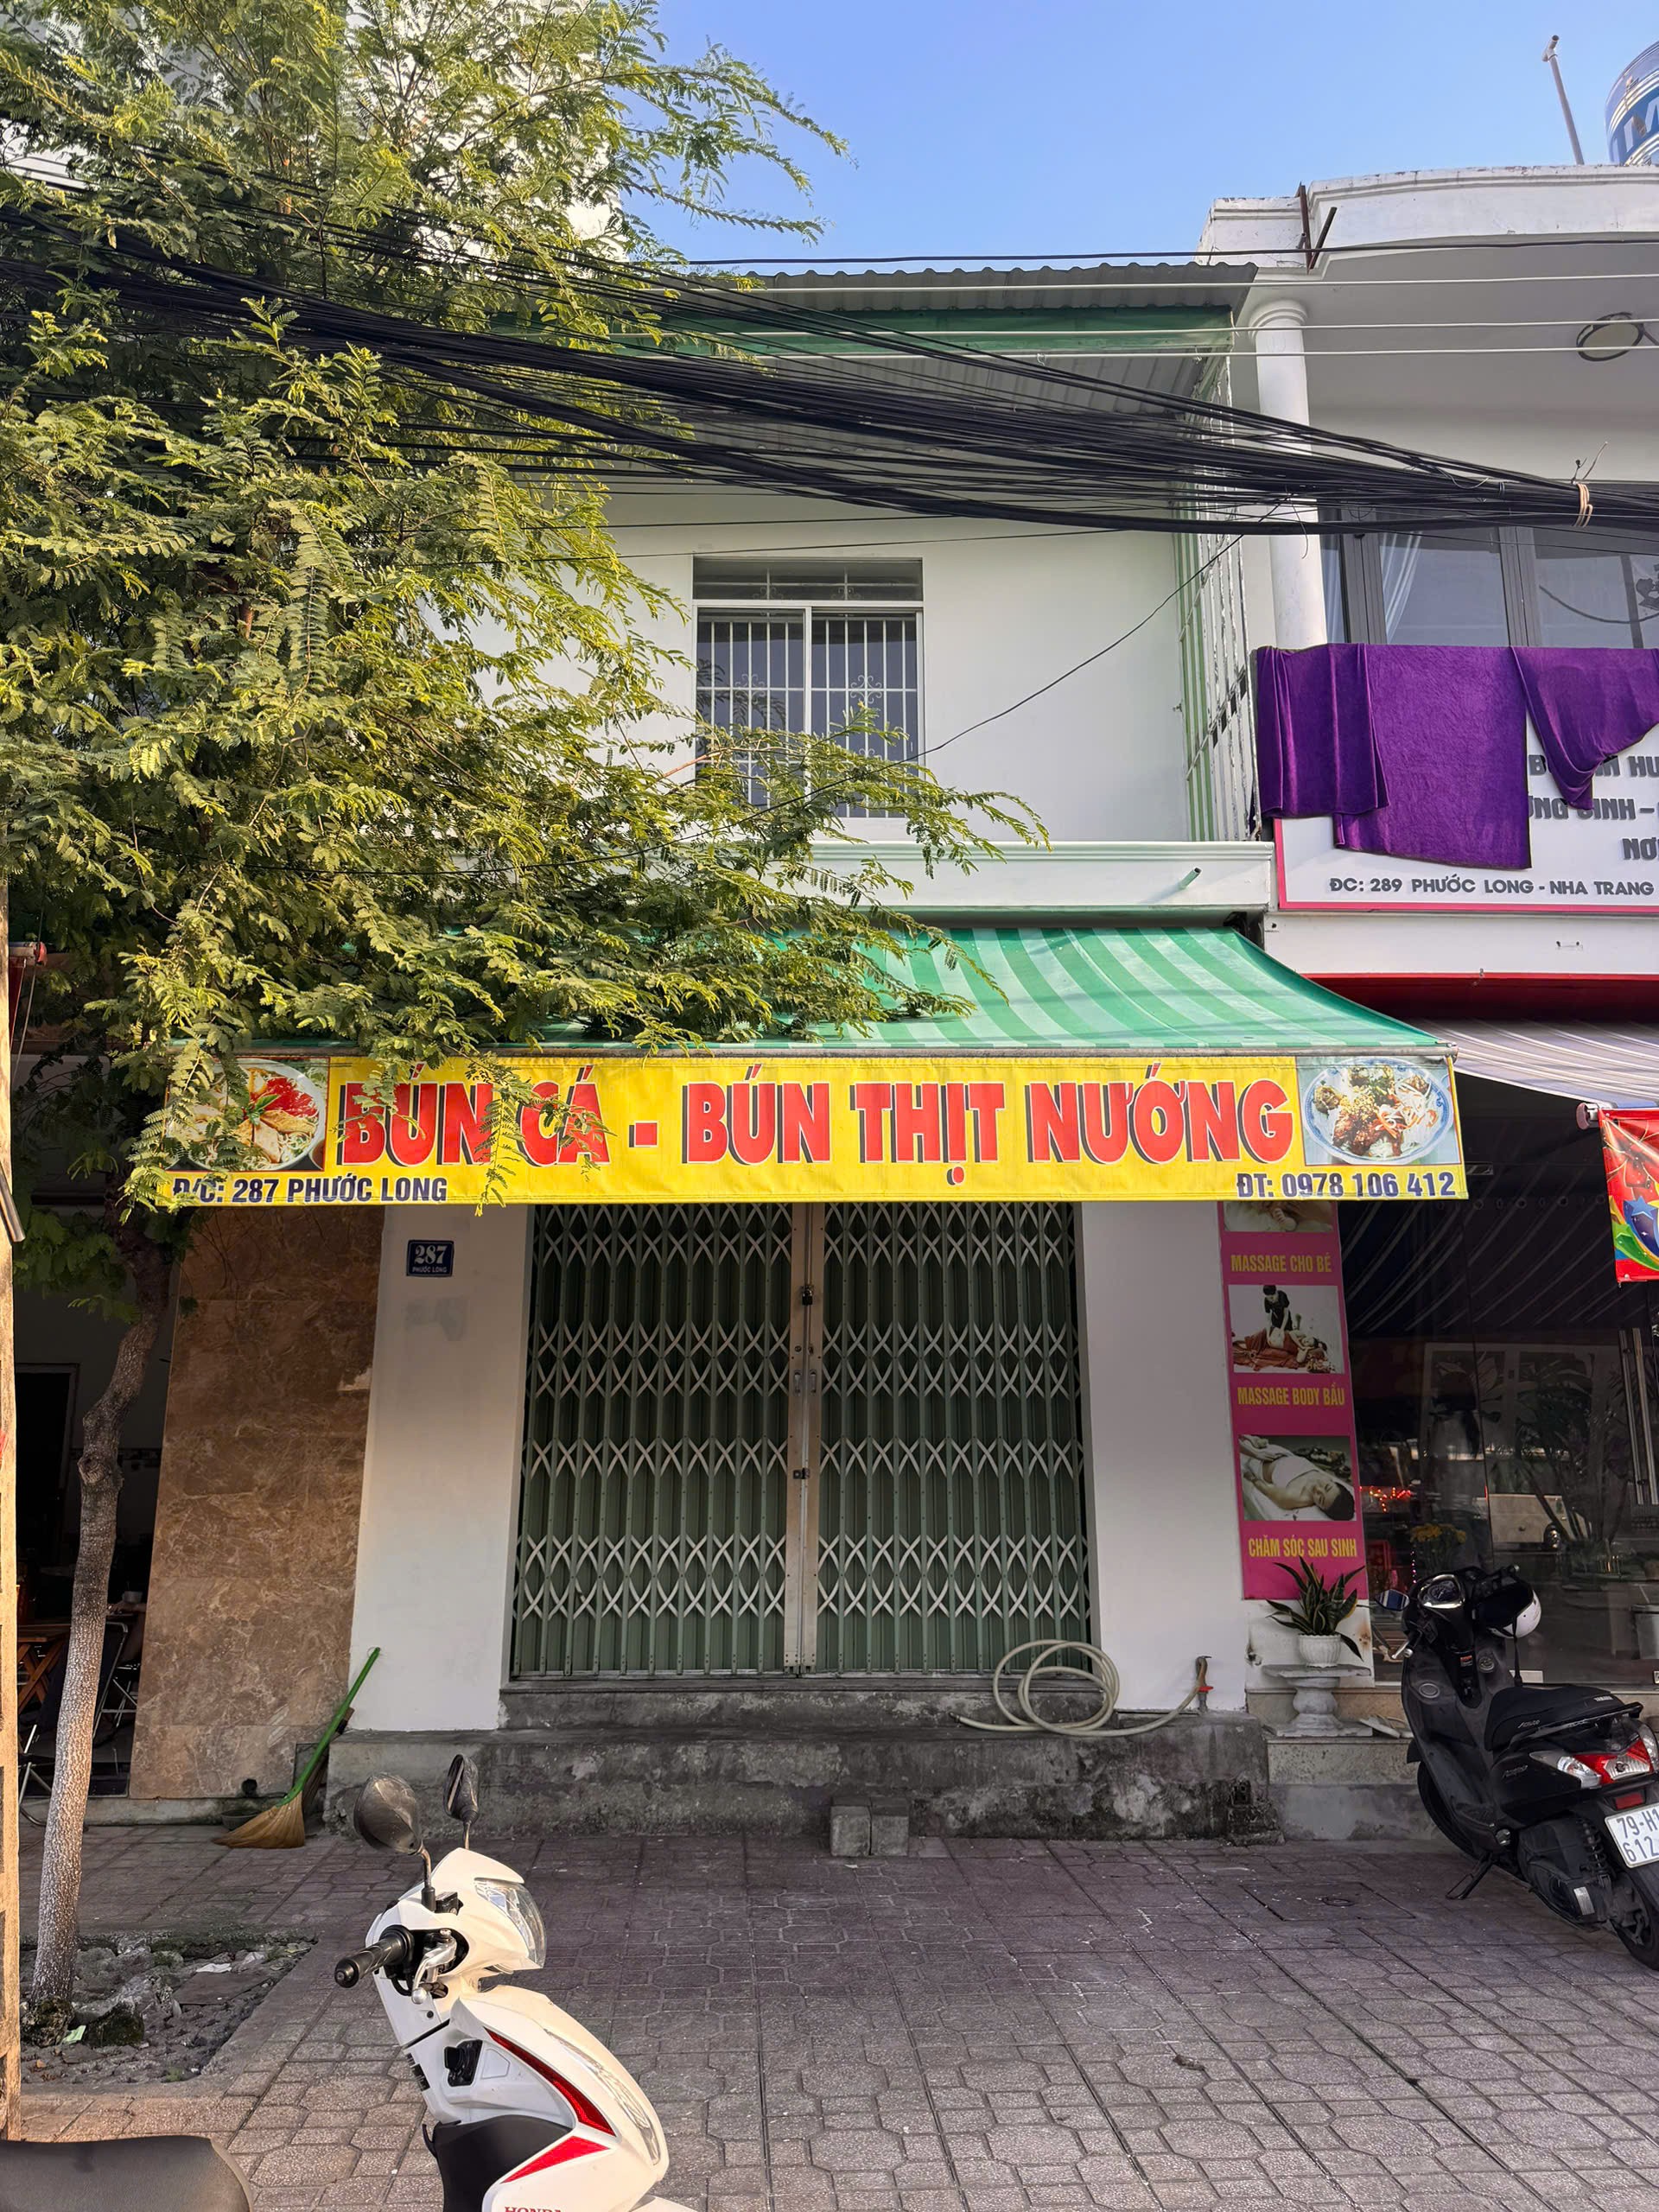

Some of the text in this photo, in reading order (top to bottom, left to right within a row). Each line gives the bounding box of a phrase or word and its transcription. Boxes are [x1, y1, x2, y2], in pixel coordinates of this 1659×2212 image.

[1329, 877, 1364, 893] ĐC:
[1370, 878, 1402, 893] 289
[1411, 874, 1476, 893] PHƯỚC
[1484, 879, 1534, 893] LONG
[1549, 880, 1588, 895] NHA
[1594, 880, 1655, 896] TRANG
[336, 1062, 493, 1166] BÚN
[518, 1064, 611, 1166] CÁ
[682, 1063, 830, 1166] BÚN
[849, 1082, 1006, 1186] THỊT
[1026, 1062, 1294, 1165] NƯỚNG
[232, 1178, 279, 1204] 287
[286, 1172, 372, 1203] PHƯỚC
[380, 1176, 448, 1202] LONG
[1236, 1172, 1456, 1198] ĐT: 0978 106 412
[415, 1244, 448, 1264] 287
[1230, 1252, 1332, 1273] MASSAGE CHO BÉ
[1237, 1382, 1345, 1406] MASSAGE BODY BẦU
[1248, 1534, 1357, 1558] CHĂM SÓC SAU SINH
